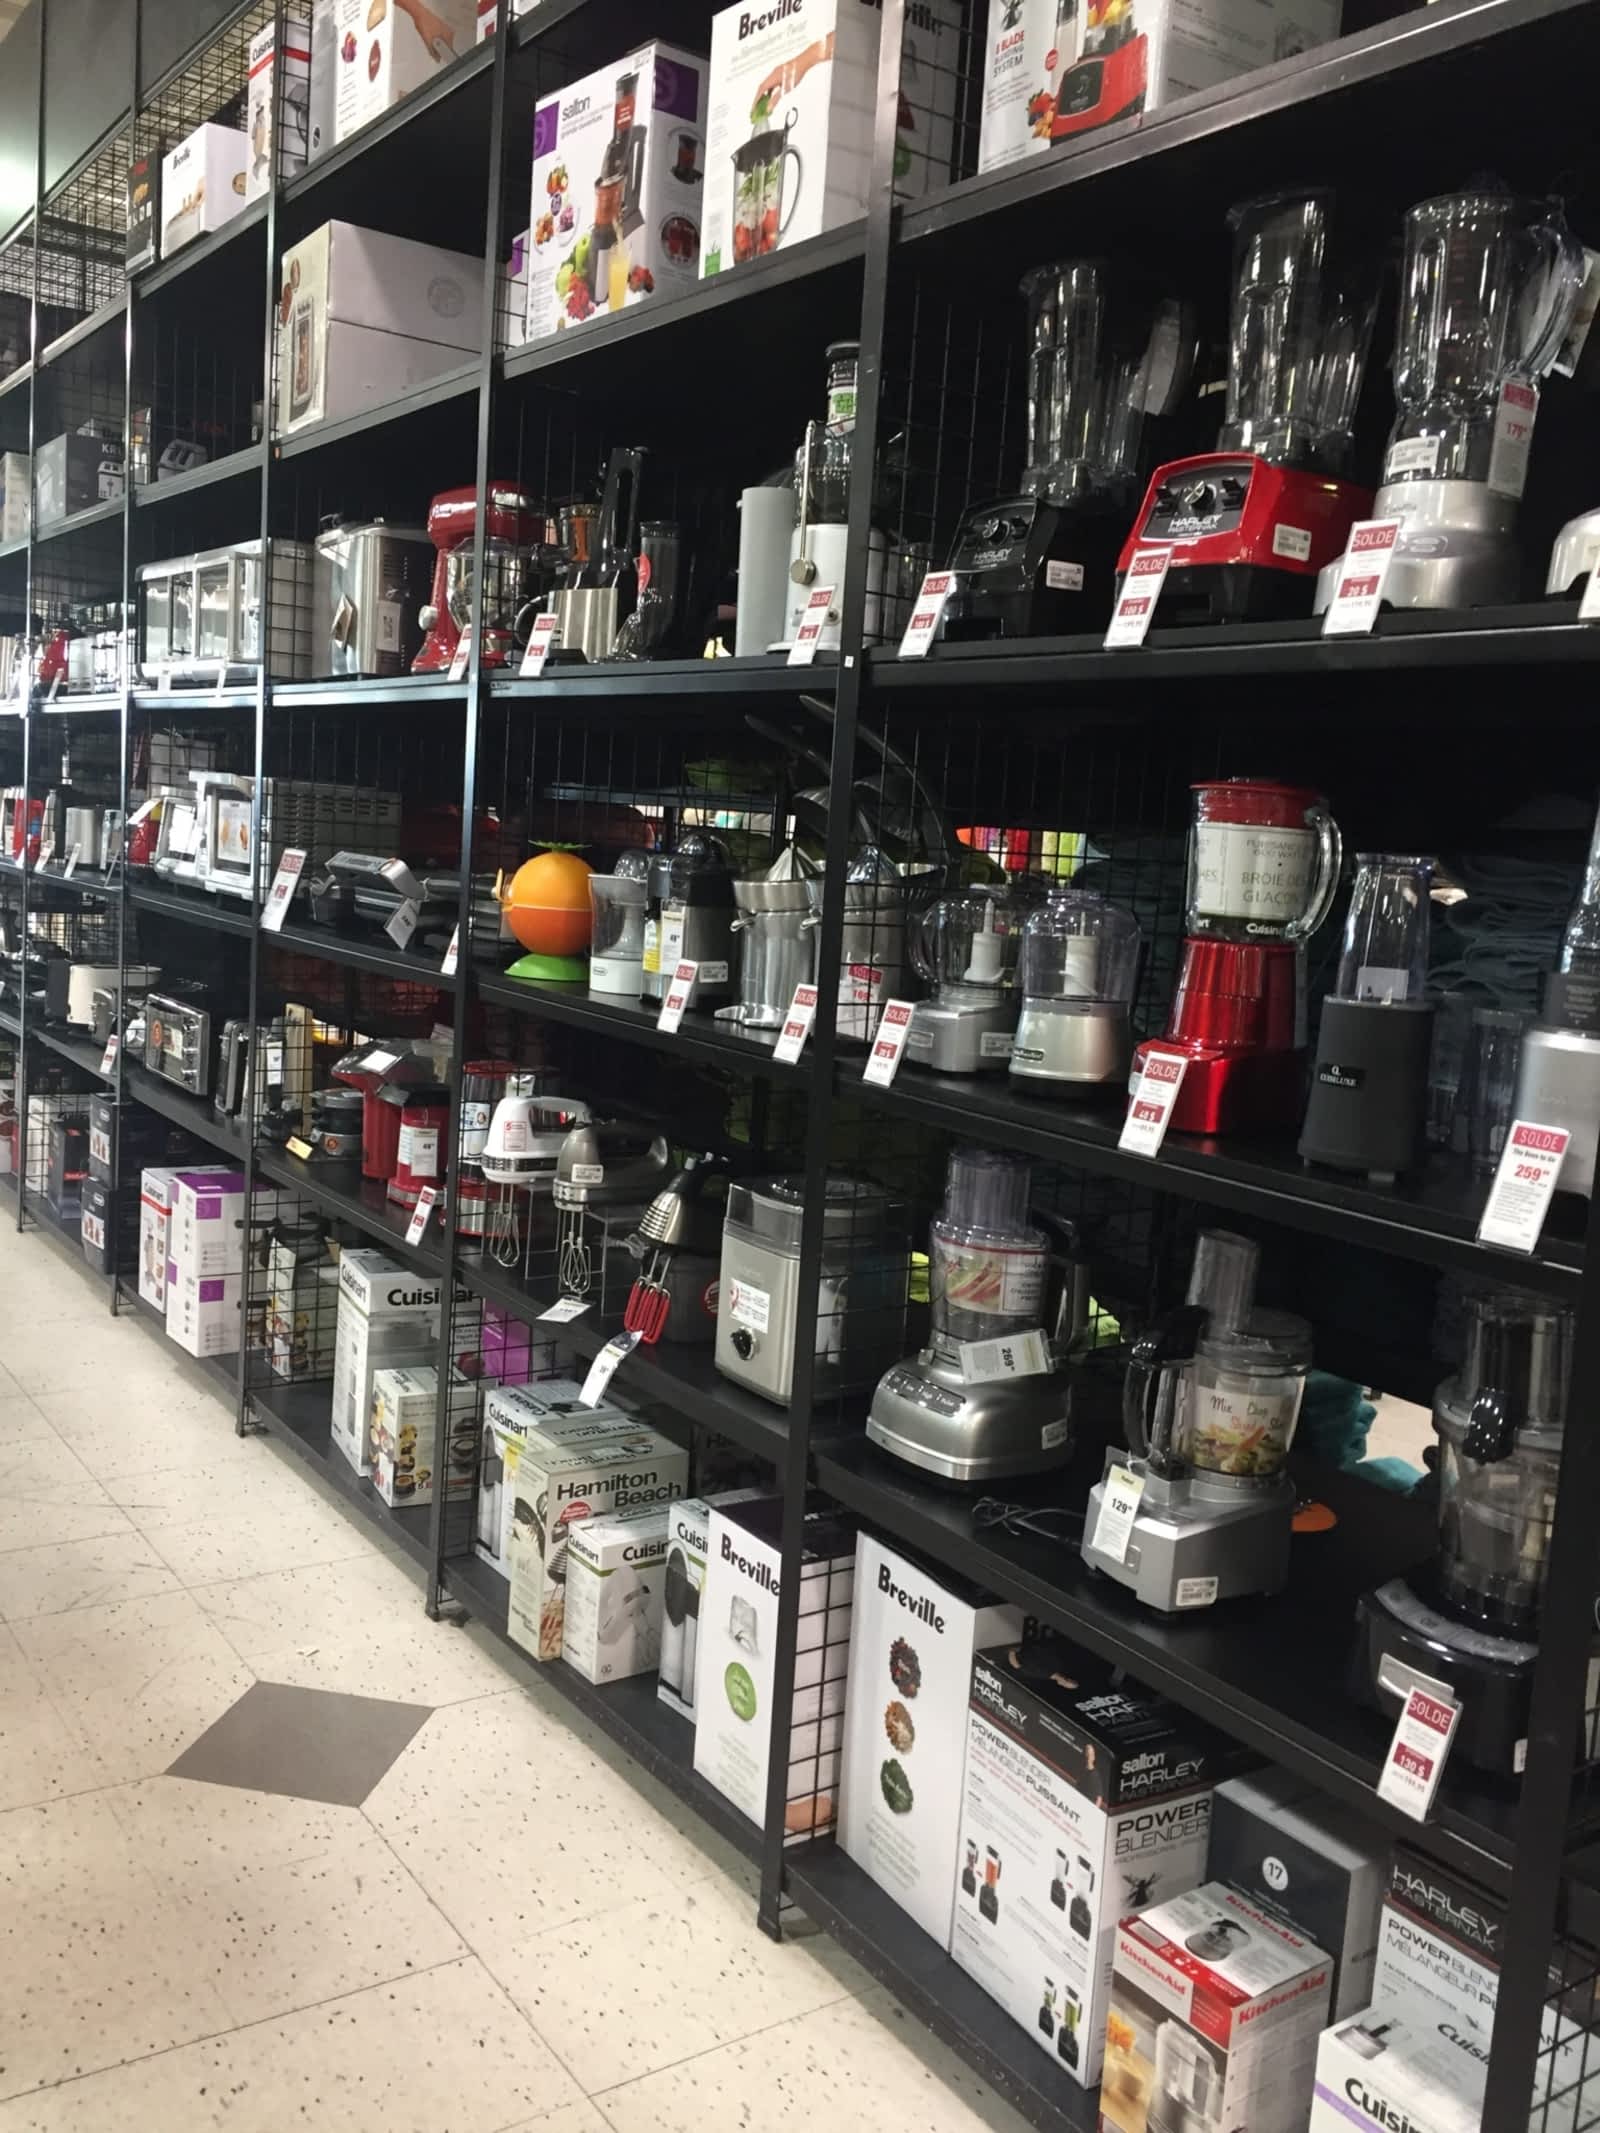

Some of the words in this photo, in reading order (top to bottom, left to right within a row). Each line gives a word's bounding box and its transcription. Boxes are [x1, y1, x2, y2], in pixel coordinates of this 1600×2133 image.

[1353, 529, 1394, 548] SOLDE
[1132, 556, 1164, 572] SOLDE
[1241, 871, 1284, 887] BROIE
[887, 1008, 909, 1023] SOLDE
[1146, 1062, 1179, 1080] SOLDE
[1519, 1129, 1560, 1151] SOLDE
[488, 1402, 528, 1437] Cuisinart
[557, 1471, 658, 1500] Hamilton
[615, 1481, 682, 1508] Beach
[568, 1534, 599, 1564] Cuisinart
[721, 1532, 781, 1597] Breville
[878, 1563, 945, 1634] Breville
[973, 1680, 1028, 1724] HARLEY
[1408, 1698, 1451, 1729] SOLDE
[1120, 1757, 1205, 1792] HARLEY
[1121, 1751, 1165, 1775] salton
[1116, 1798, 1210, 1838] POWER
[1115, 1815, 1209, 1857] BLENDER
[1268, 1862, 1283, 1881] 17
[1392, 1880, 1496, 1951] PASTERNAK
[1393, 1864, 1499, 1936] HARLEY
[1388, 1917, 1450, 1966] POWER
[1120, 1940, 1185, 1996] KitchenAid
[1386, 1932, 1478, 1999] MÉLANGEUR
[1239, 1971, 1326, 2025] KitchenAid
